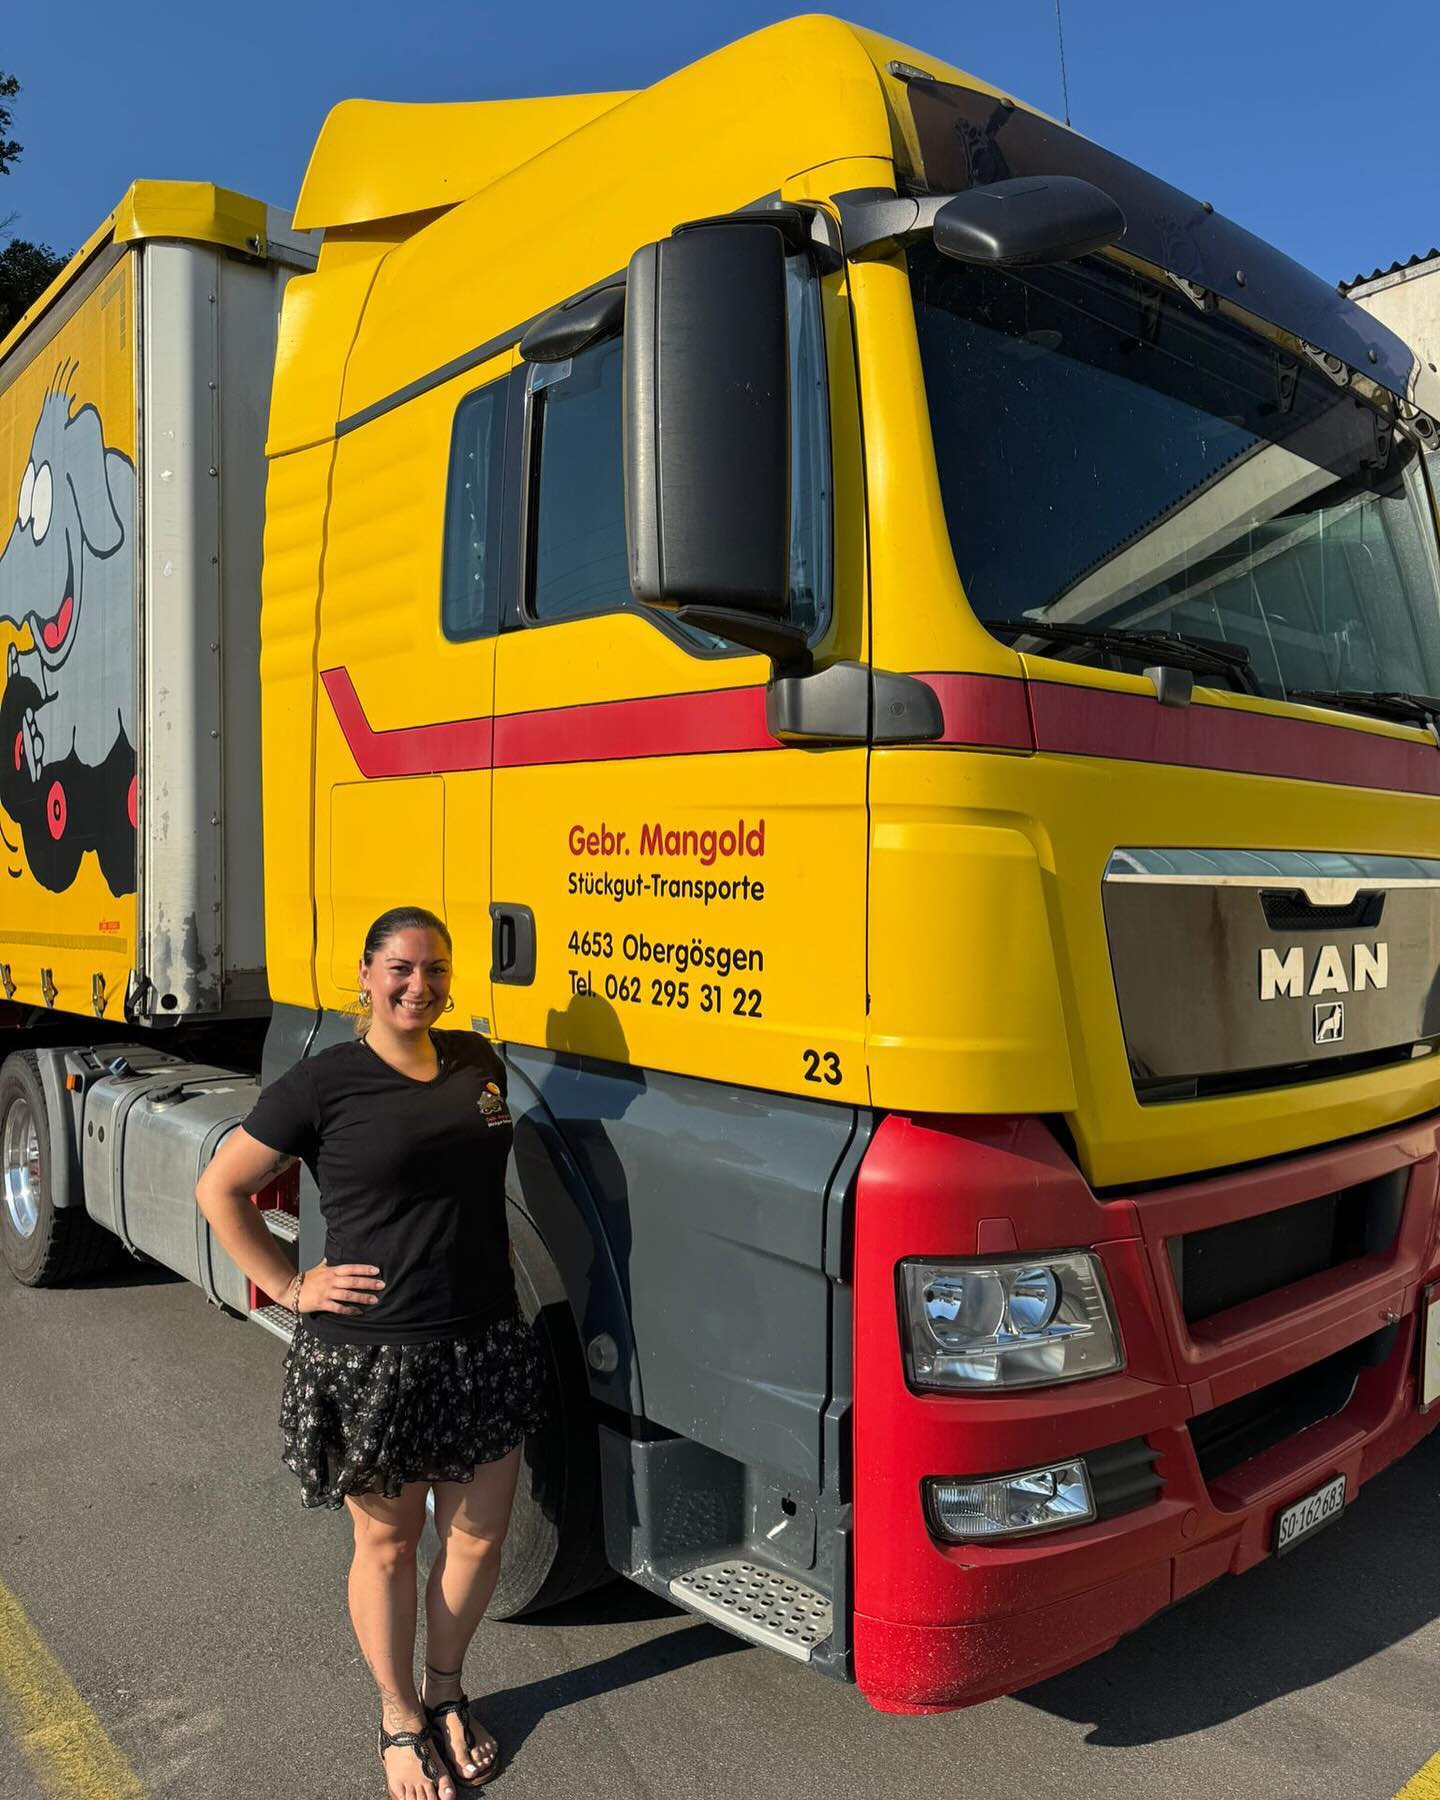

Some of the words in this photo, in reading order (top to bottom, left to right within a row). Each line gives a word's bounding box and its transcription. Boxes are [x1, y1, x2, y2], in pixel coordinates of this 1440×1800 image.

[568, 822, 630, 857] Gebr.
[639, 818, 766, 867] Mangold
[568, 871, 765, 907] Stückgut-Transporte
[567, 929, 614, 959] 4653
[622, 932, 764, 978] Obergösgen
[1260, 942, 1389, 1001] MAN
[568, 969, 597, 998] Tel.
[604, 973, 642, 1004] 062
[651, 978, 690, 1010] 295
[699, 983, 722, 1014] 31
[732, 987, 763, 1019] 22
[802, 1048, 843, 1086] 23
